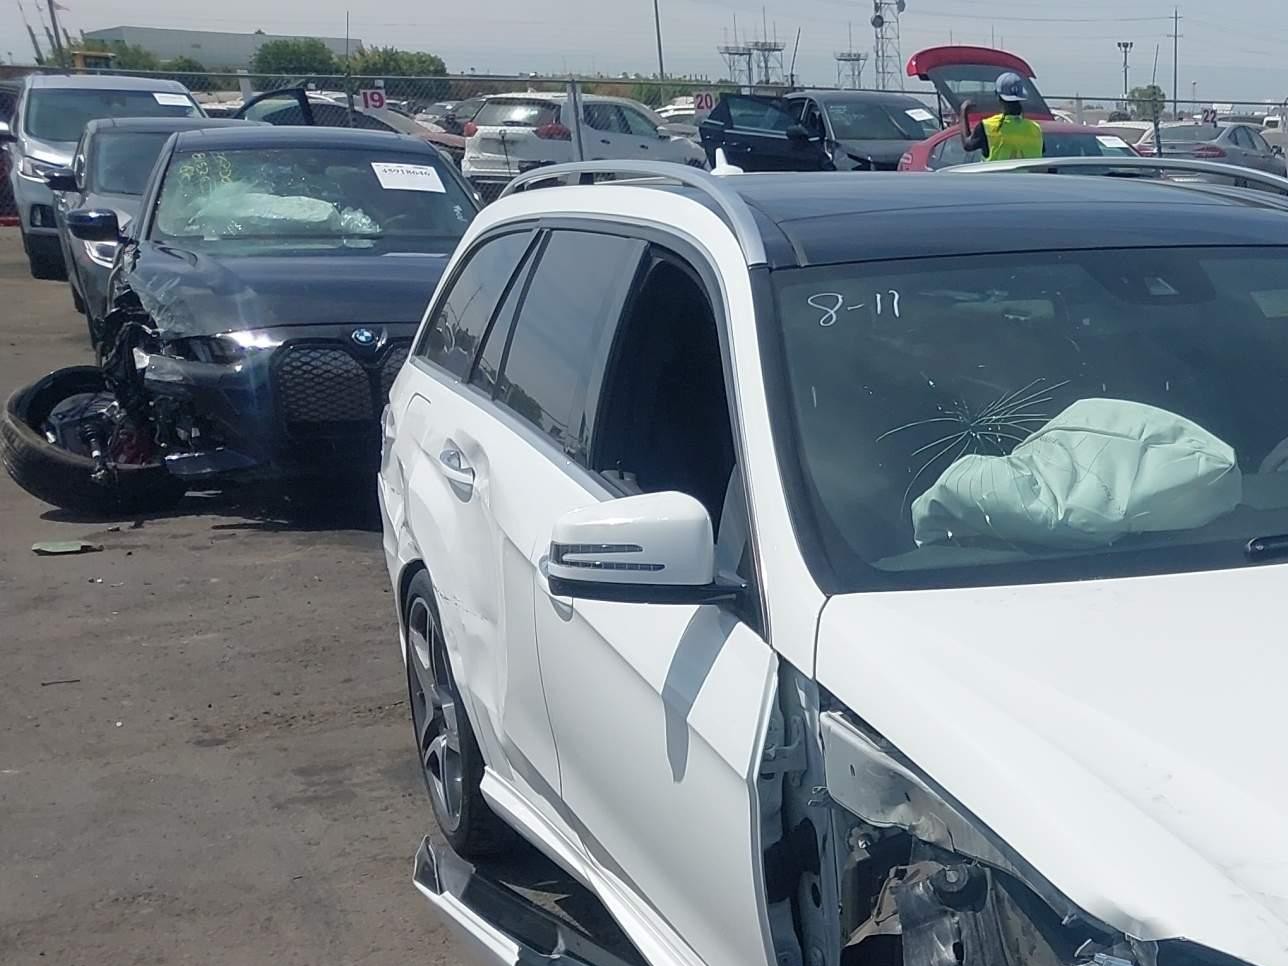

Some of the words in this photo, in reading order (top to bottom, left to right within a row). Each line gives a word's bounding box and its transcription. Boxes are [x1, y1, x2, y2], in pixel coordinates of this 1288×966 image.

[362, 91, 384, 109] 19
[695, 93, 713, 109] 20
[1203, 109, 1217, 124] 22
